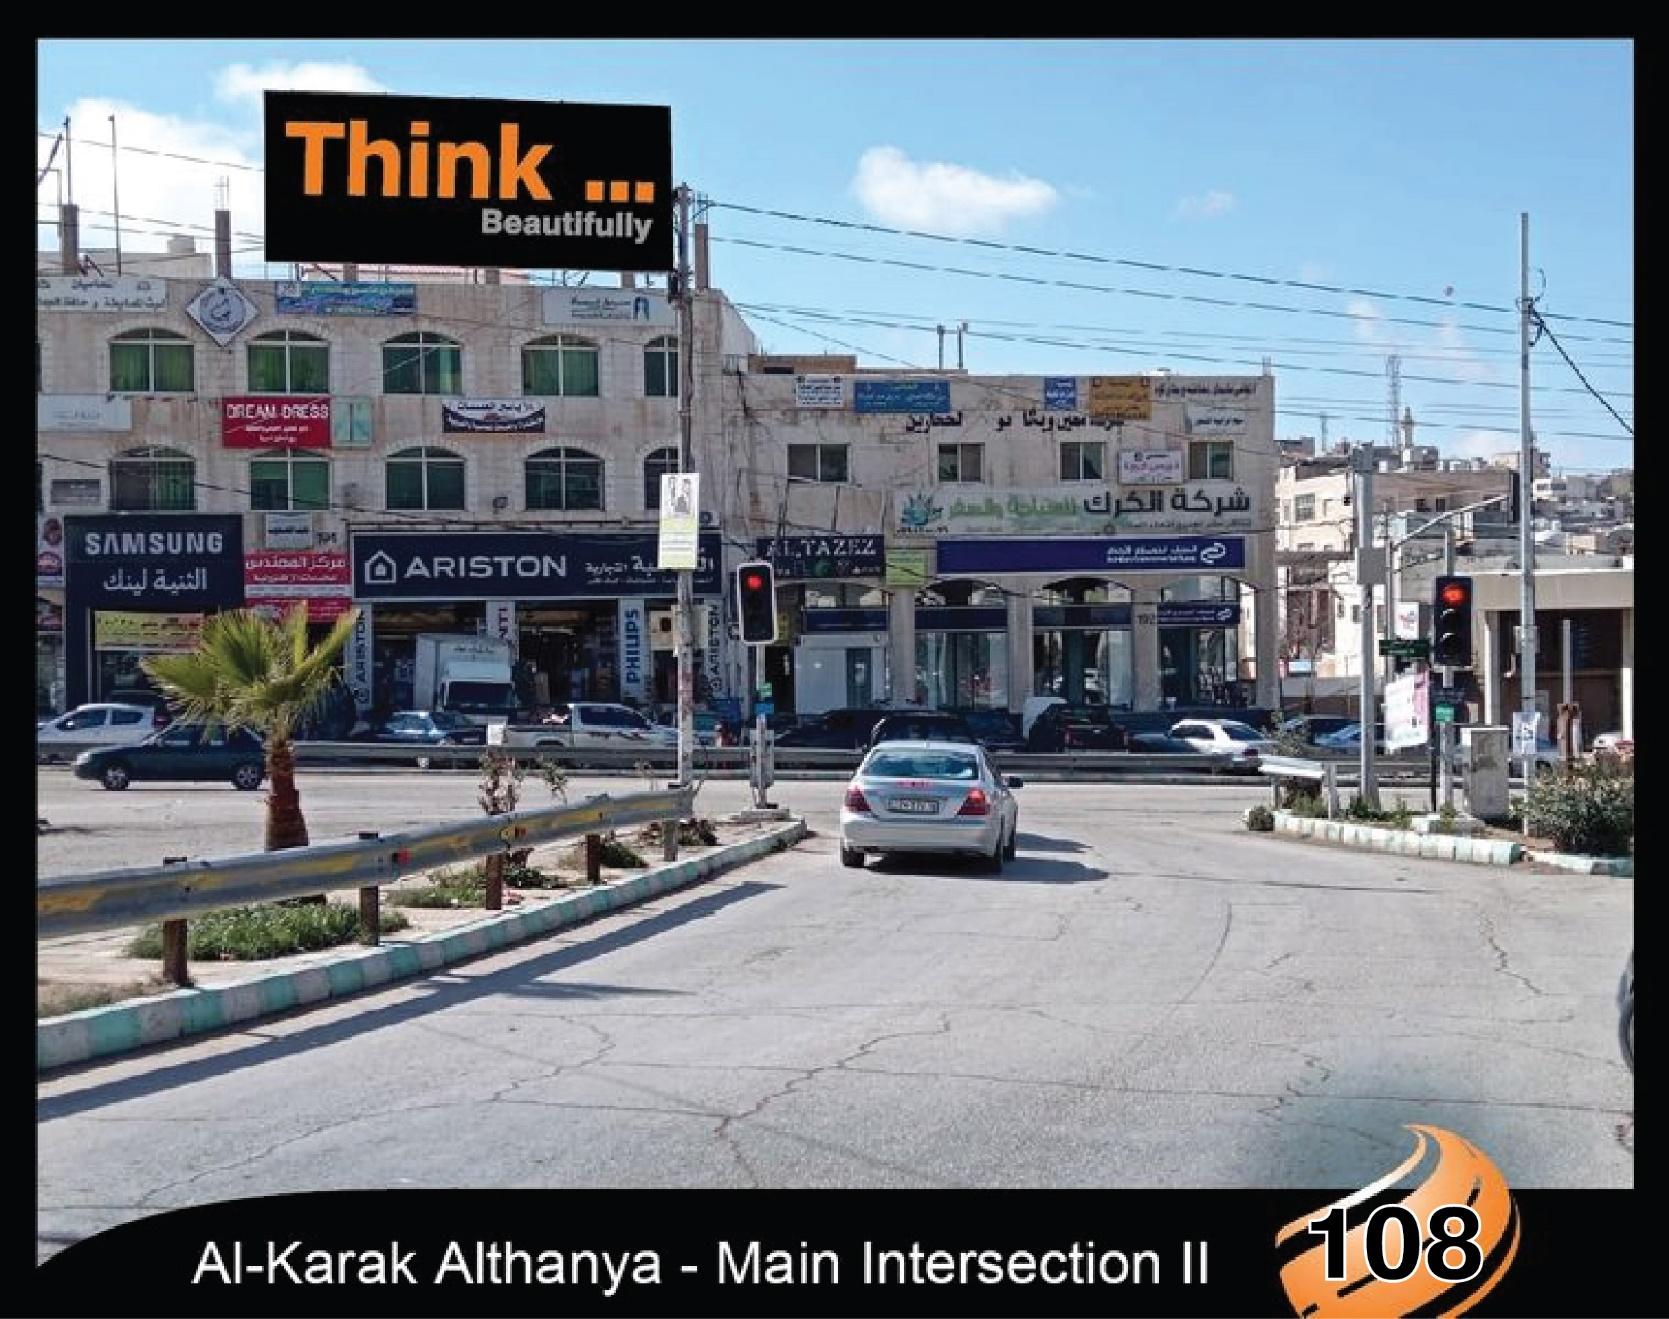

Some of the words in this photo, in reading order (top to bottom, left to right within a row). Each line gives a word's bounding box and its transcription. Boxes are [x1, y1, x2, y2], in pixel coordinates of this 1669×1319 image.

[285, 120, 553, 201] Think
[481, 208, 653, 244] Beautifully
[226, 403, 276, 420] DREAM
[281, 403, 329, 420] DRESS
[1084, 490, 1164, 518] الكرك
[1171, 486, 1250, 517] شركة
[85, 531, 223, 555] SAMSUNG
[153, 567, 208, 596] الثنية
[404, 555, 566, 579] ARISTON
[103, 567, 148, 597] لينك
